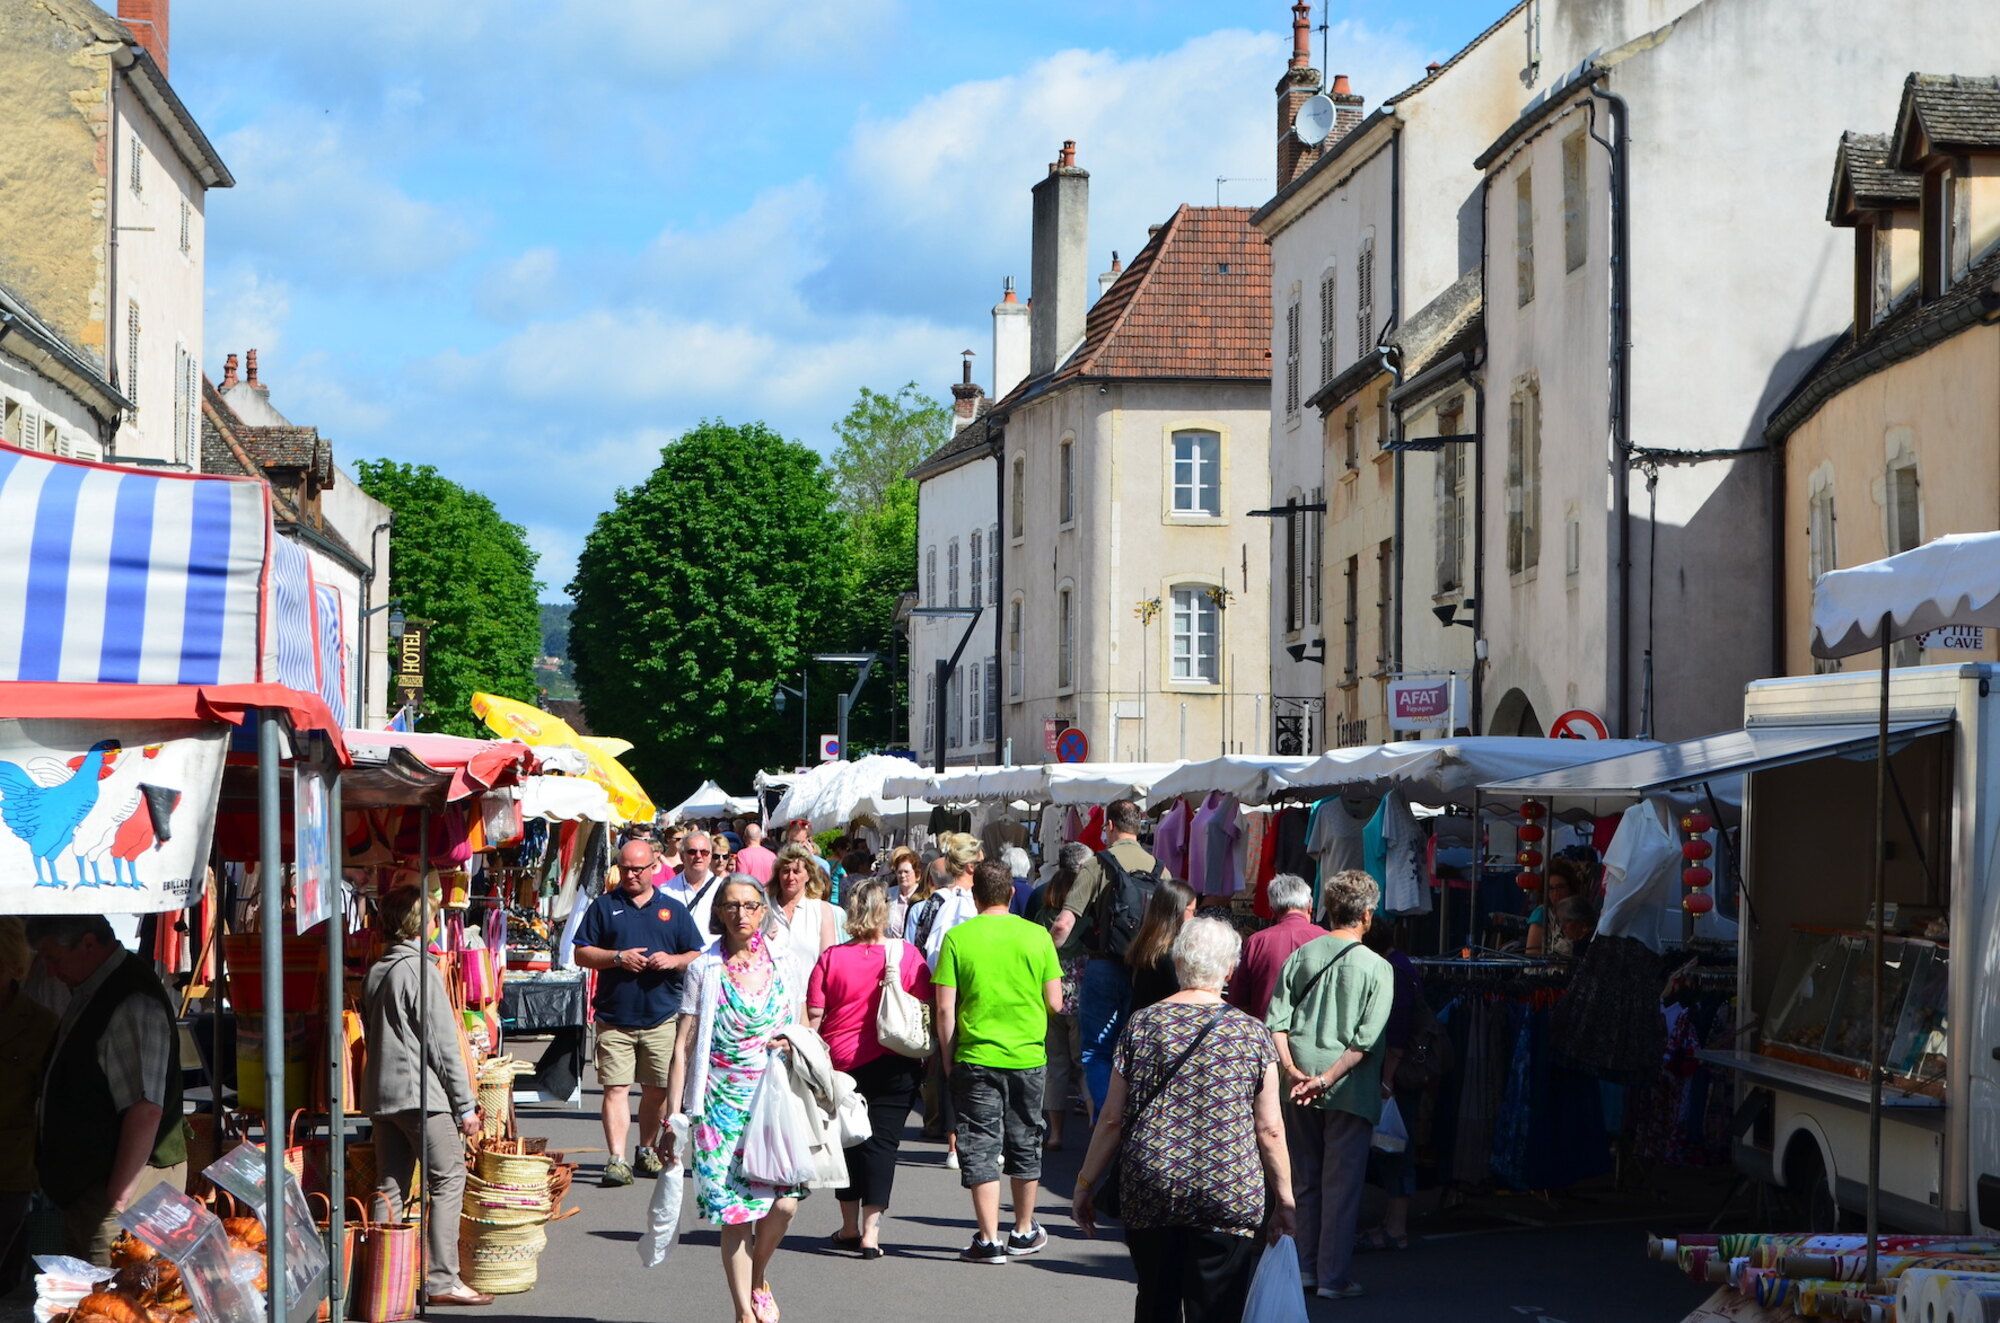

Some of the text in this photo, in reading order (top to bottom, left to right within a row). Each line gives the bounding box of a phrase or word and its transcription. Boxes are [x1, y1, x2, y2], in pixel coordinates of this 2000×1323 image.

[1938, 625, 1983, 637] PTITE
[1944, 636, 1983, 650] CAVE
[402, 630, 421, 673] HOTEL
[1400, 690, 1439, 705] AFAT
